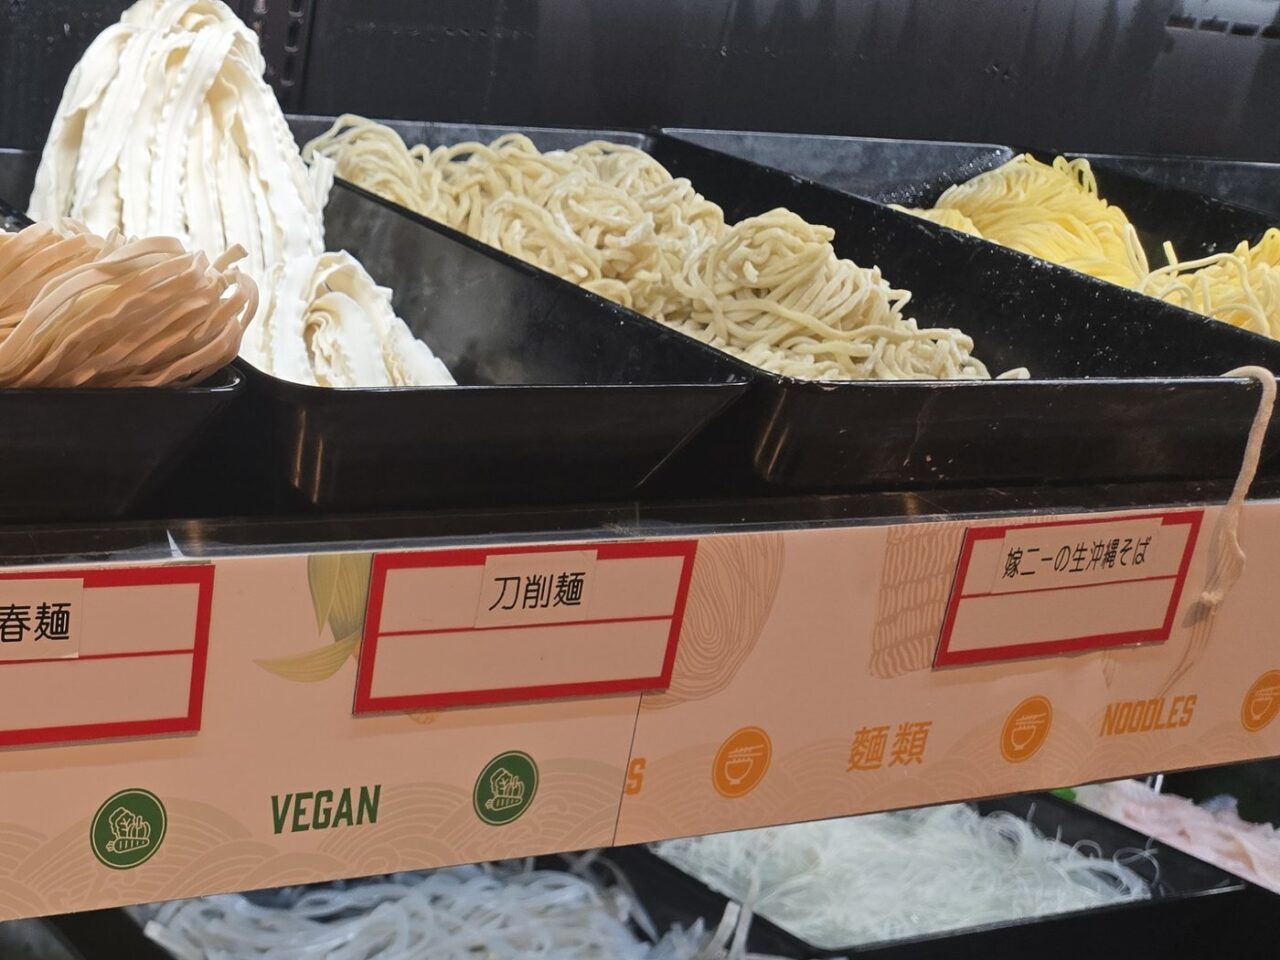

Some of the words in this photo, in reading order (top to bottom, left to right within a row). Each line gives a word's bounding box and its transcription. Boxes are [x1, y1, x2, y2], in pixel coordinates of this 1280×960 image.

[488, 571, 586, 611] 刀削麺
[1099, 694, 1198, 736] NOODLES
[271, 784, 382, 834] VEGAN
